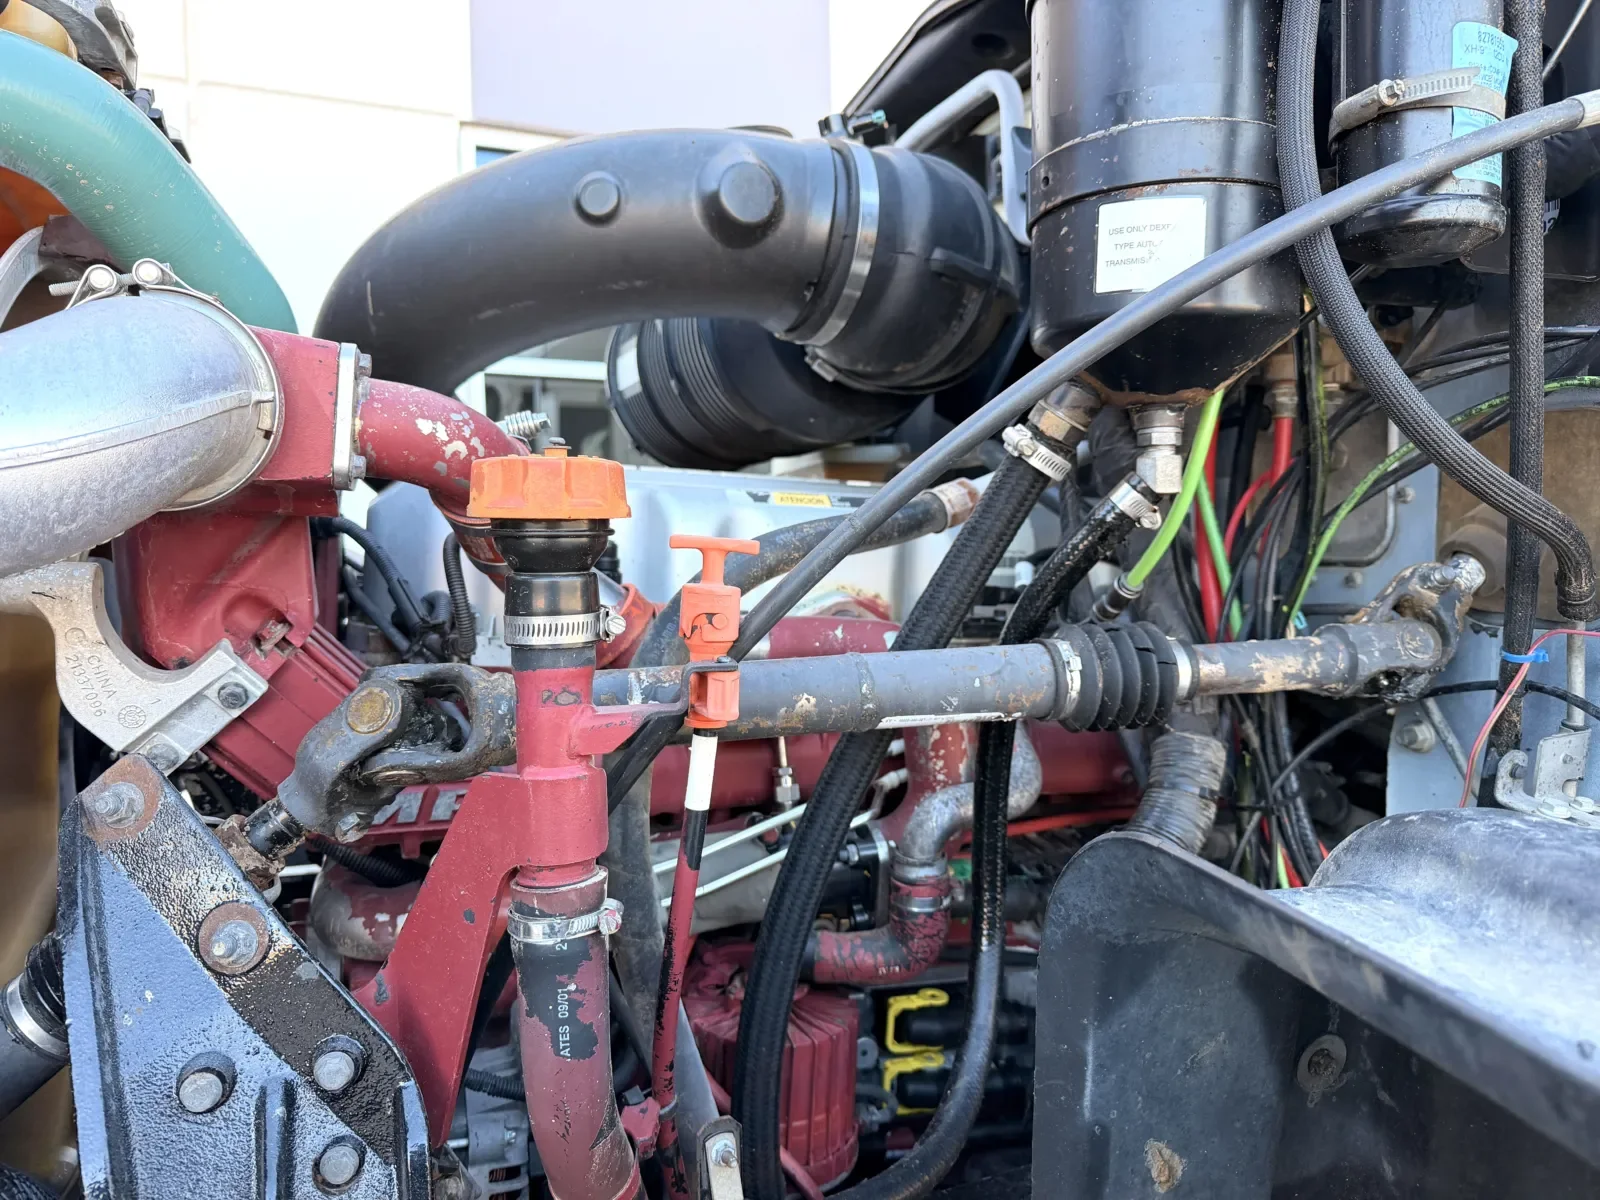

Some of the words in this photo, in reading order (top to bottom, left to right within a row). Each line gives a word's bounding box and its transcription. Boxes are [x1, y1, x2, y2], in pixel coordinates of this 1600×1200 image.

[1108, 226, 1125, 236] USE
[1126, 224, 1148, 234] ONLY
[1114, 241, 1135, 251] TYPE
[65, 654, 107, 717] 21337096
[87, 654, 118, 698] CHINA
[557, 988, 569, 1018] 09/01
[558, 1025, 571, 1062] ATES
